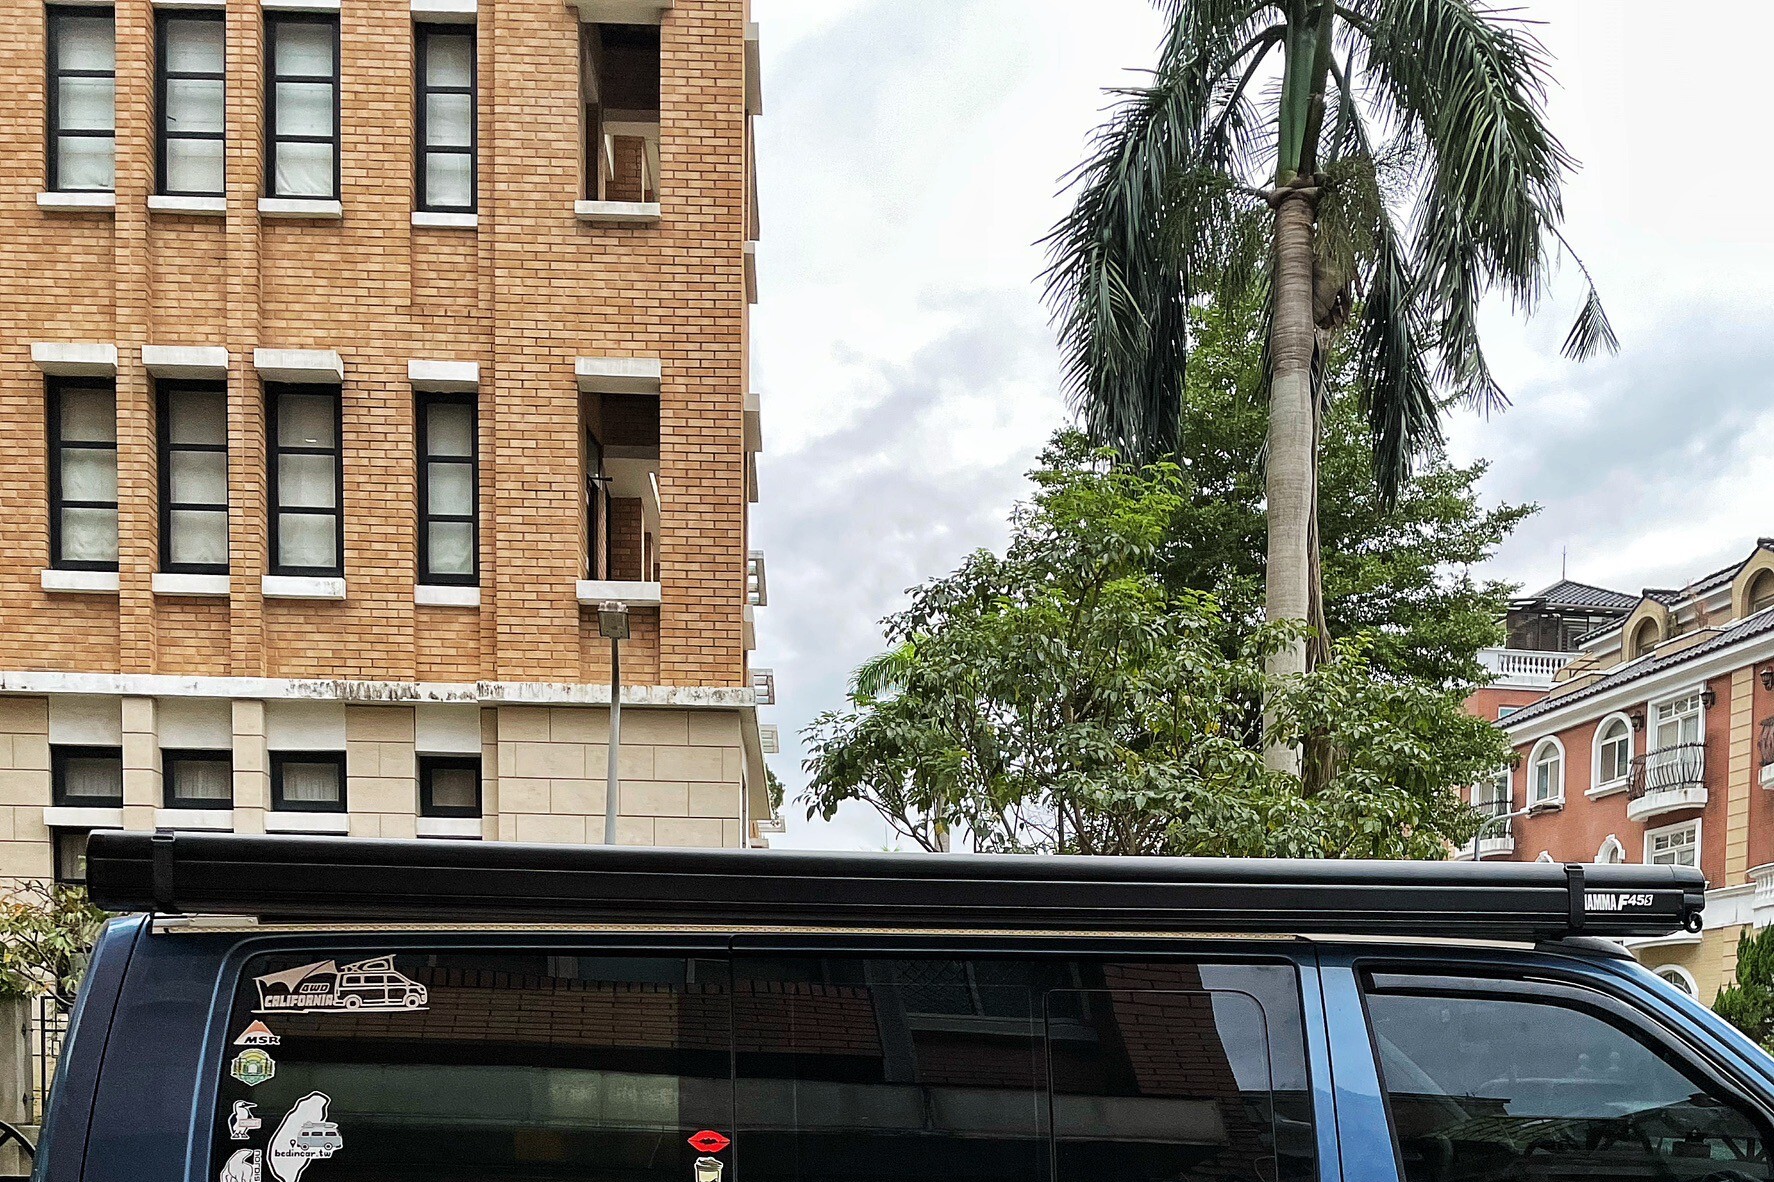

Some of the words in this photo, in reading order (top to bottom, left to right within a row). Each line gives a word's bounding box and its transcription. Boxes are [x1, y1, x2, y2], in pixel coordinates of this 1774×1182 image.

[1584, 894, 1617, 911] IAMMA
[301, 984, 328, 992] 4WD
[264, 994, 335, 1007] CALIFORNIA
[244, 1036, 280, 1044] MSR
[274, 1149, 332, 1157] bedincar.tw
